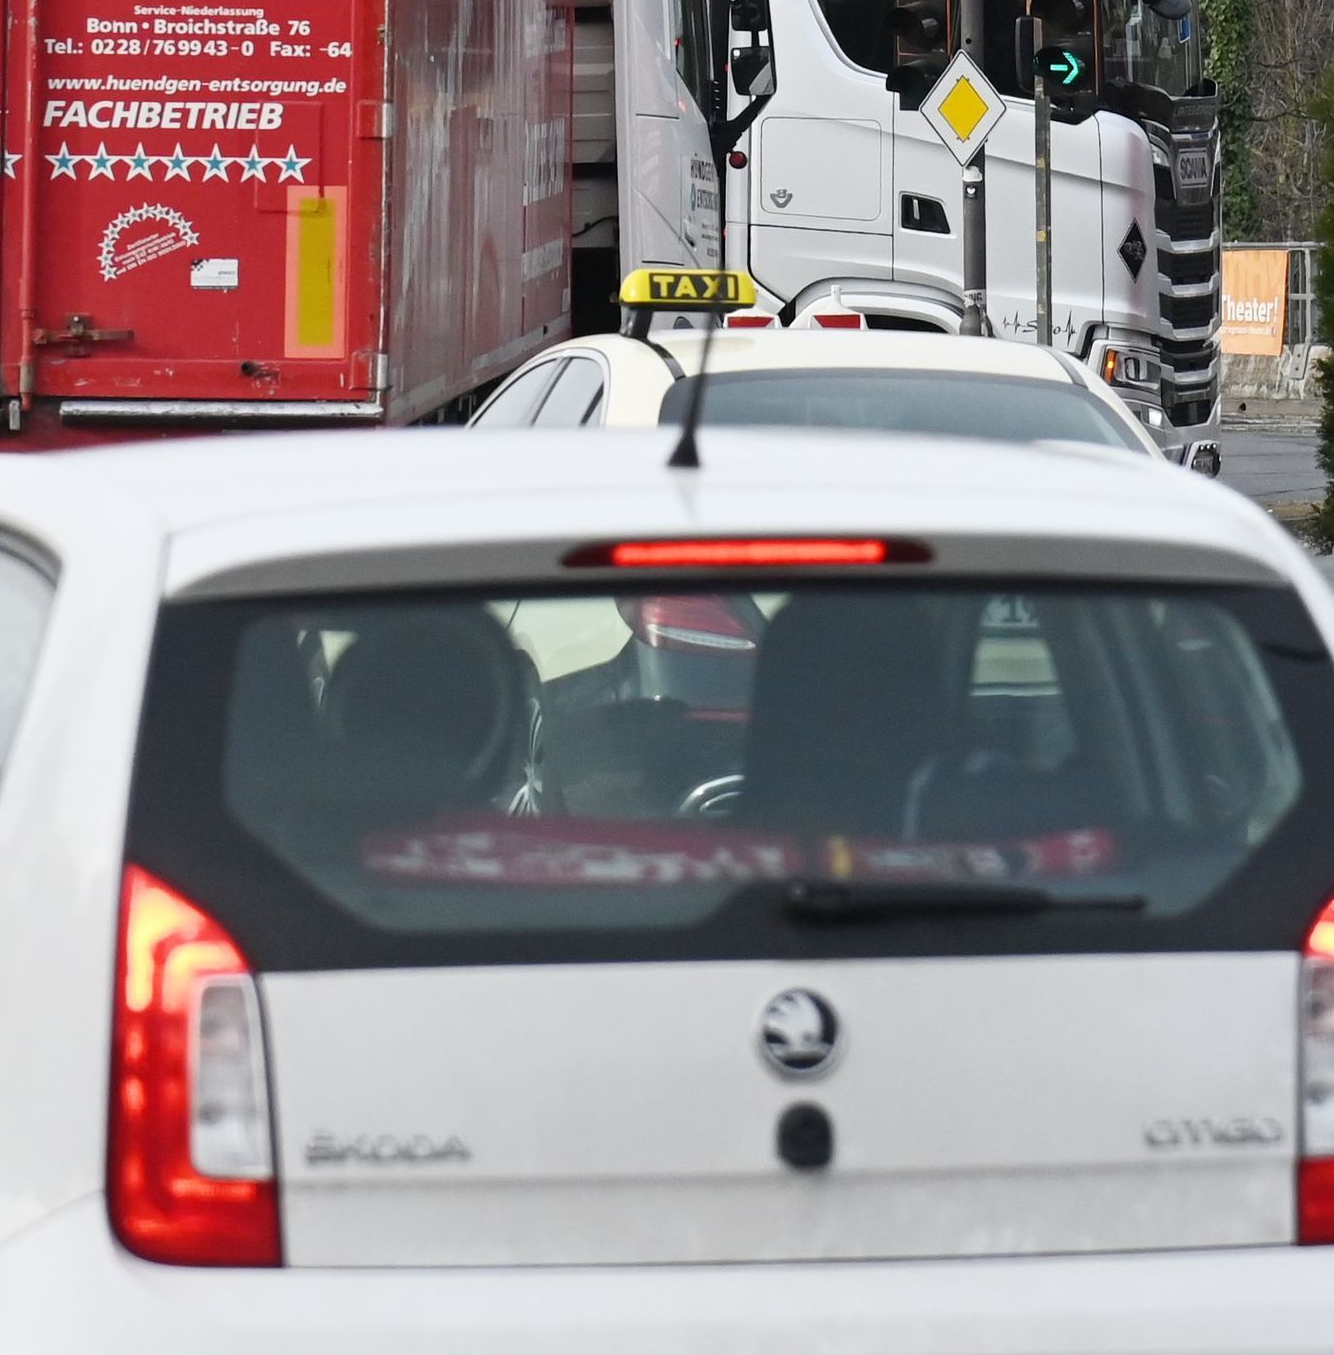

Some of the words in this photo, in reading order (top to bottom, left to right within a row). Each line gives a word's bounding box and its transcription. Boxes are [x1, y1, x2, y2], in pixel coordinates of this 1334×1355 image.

[133, 5, 264, 18] Service-Niederlassung
[86, 17, 138, 34] Bonn
[154, 18, 280, 36] Broichstraße
[288, 20, 310, 36] 76
[44, 38, 83, 55] Tel.:
[270, 41, 311, 57] Fax:
[319, 42, 352, 57] -64
[47, 76, 347, 96] www.huendgen-entsorgung.de
[43, 100, 284, 130] FACHBETRIEB
[652, 275, 735, 298] TAXI
